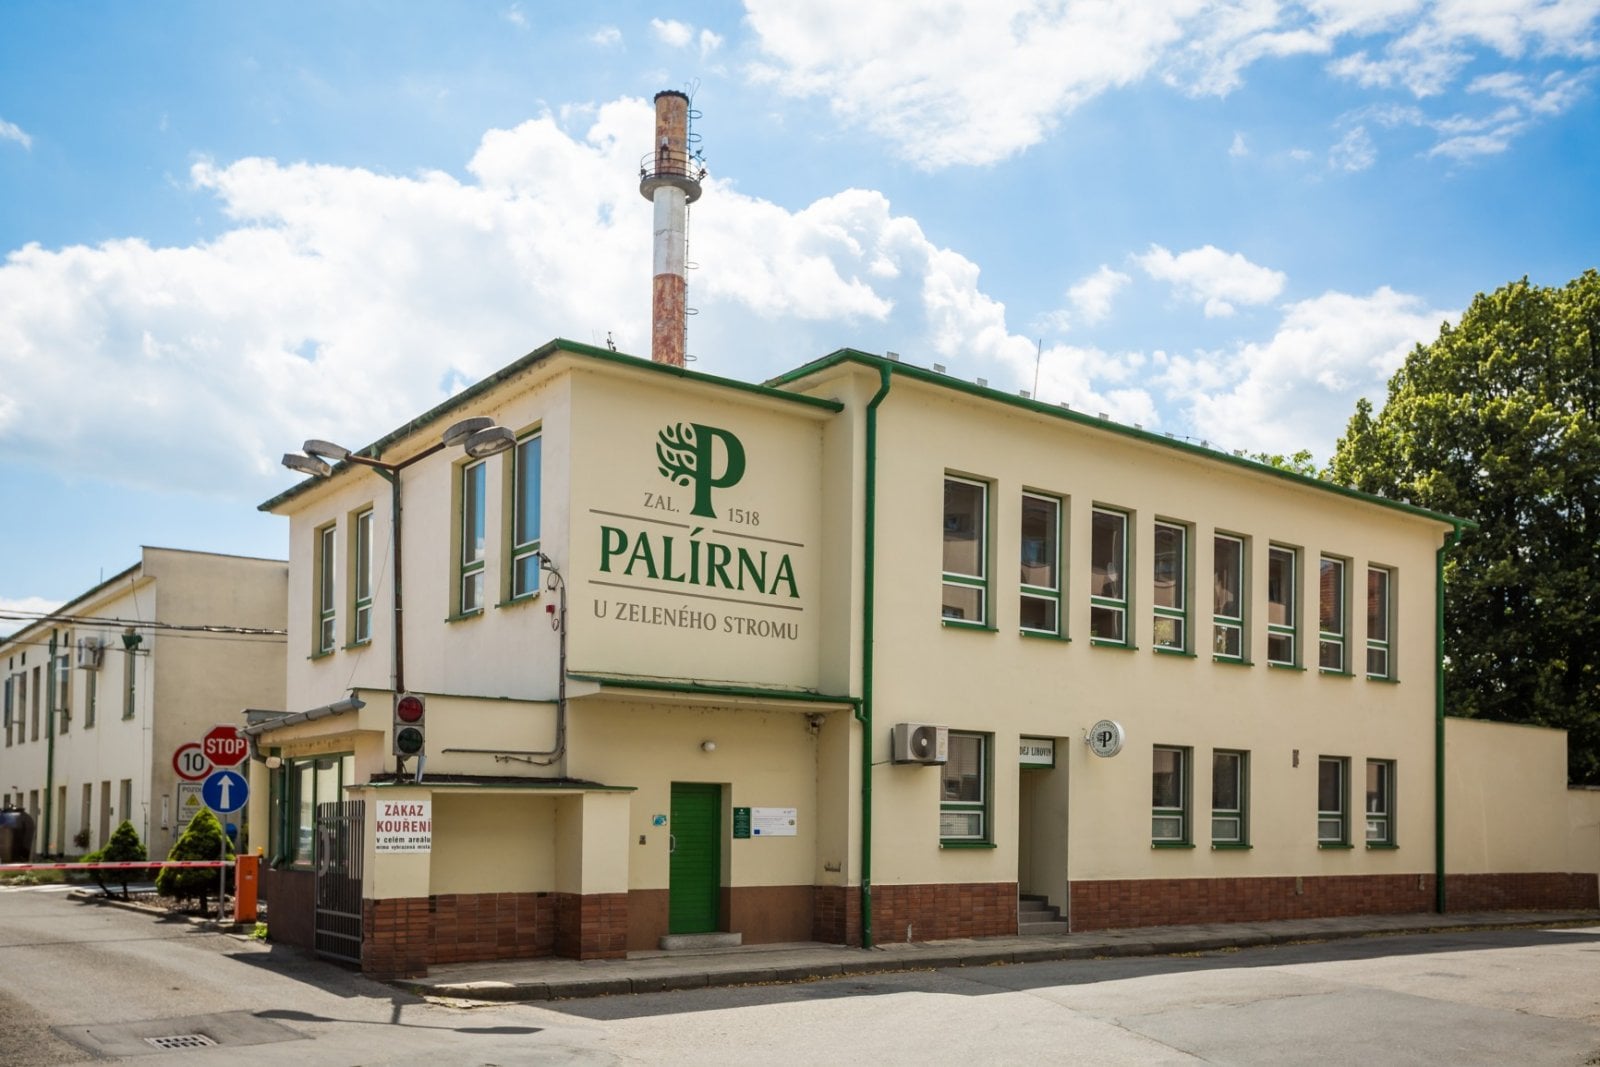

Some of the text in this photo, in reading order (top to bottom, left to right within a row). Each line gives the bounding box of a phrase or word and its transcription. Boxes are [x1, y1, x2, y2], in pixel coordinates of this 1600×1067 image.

[643, 492, 760, 526] ZAL. 1518
[599, 525, 800, 599] PALÍRNA
[594, 599, 799, 640] U ZELENÉHO STROMU
[206, 738, 245, 755] STOP
[183, 752, 204, 771] 10
[384, 801, 424, 817] ZÁKAZ
[408, 835, 431, 843] areálu
